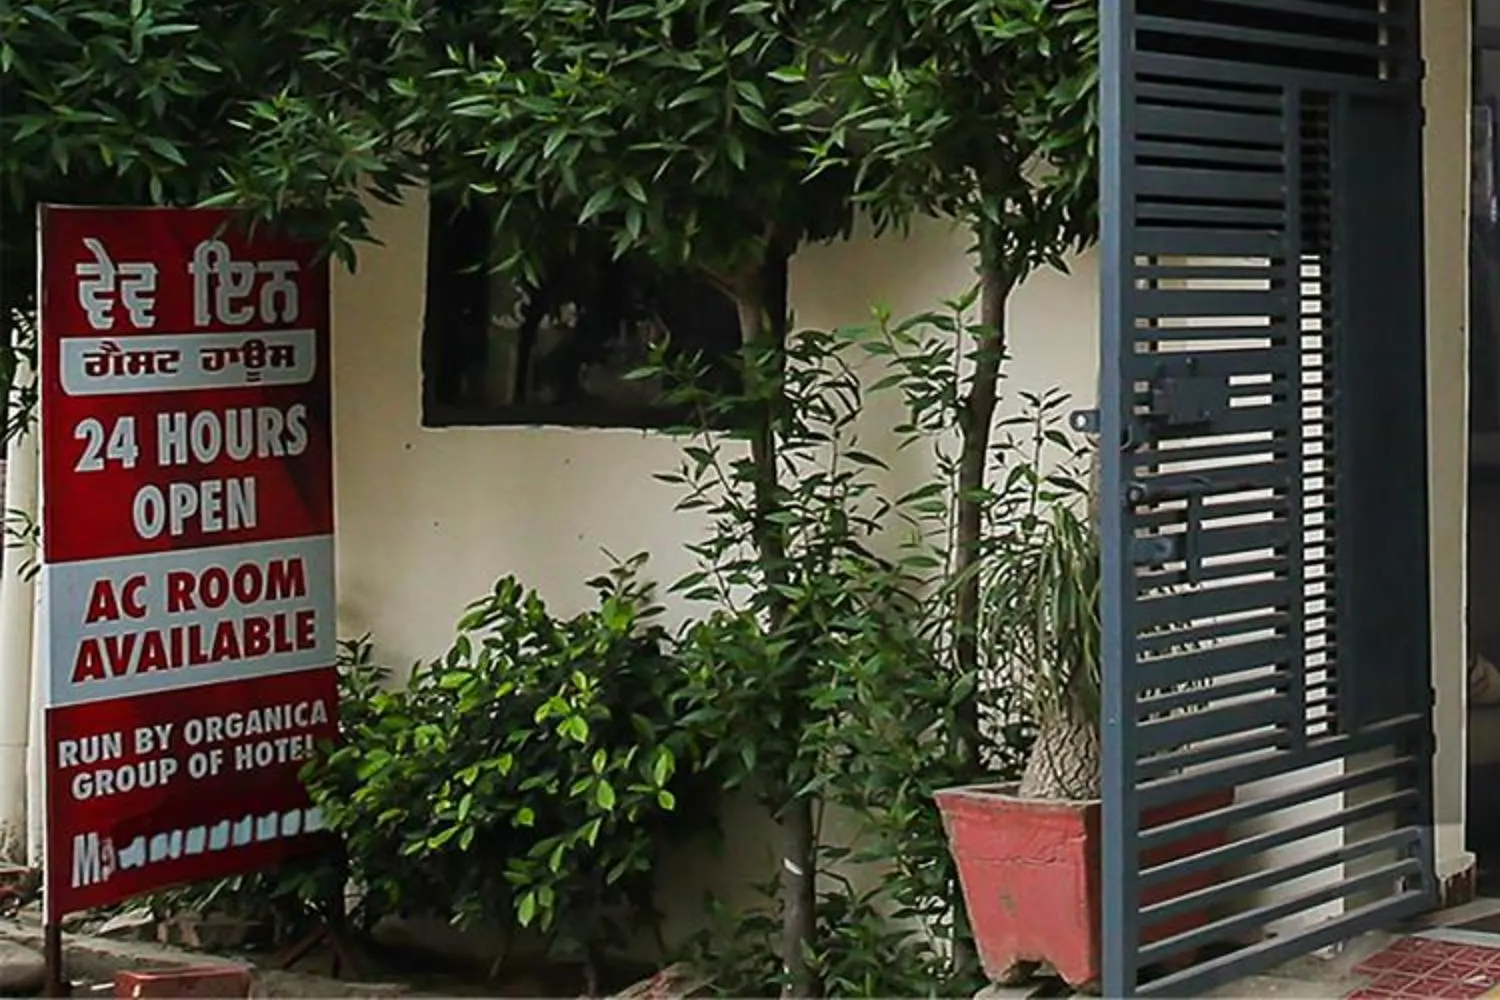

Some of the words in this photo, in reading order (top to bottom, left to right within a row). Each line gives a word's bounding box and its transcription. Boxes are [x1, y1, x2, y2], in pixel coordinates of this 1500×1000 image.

[76, 237, 159, 329] ਵੇਵ
[188, 240, 301, 327] ਇਨ
[74, 416, 139, 473] 24
[157, 404, 308, 467] HOURS
[132, 476, 258, 539] OPEN
[85, 575, 147, 624] AC
[166, 558, 306, 614] ROOM
[71, 609, 316, 683] AVAILABLE
[58, 731, 122, 768] RUN
[135, 723, 173, 755] BY
[183, 699, 328, 747] ORGANICA
[71, 757, 178, 801] GROUP
[188, 752, 224, 780] OF
